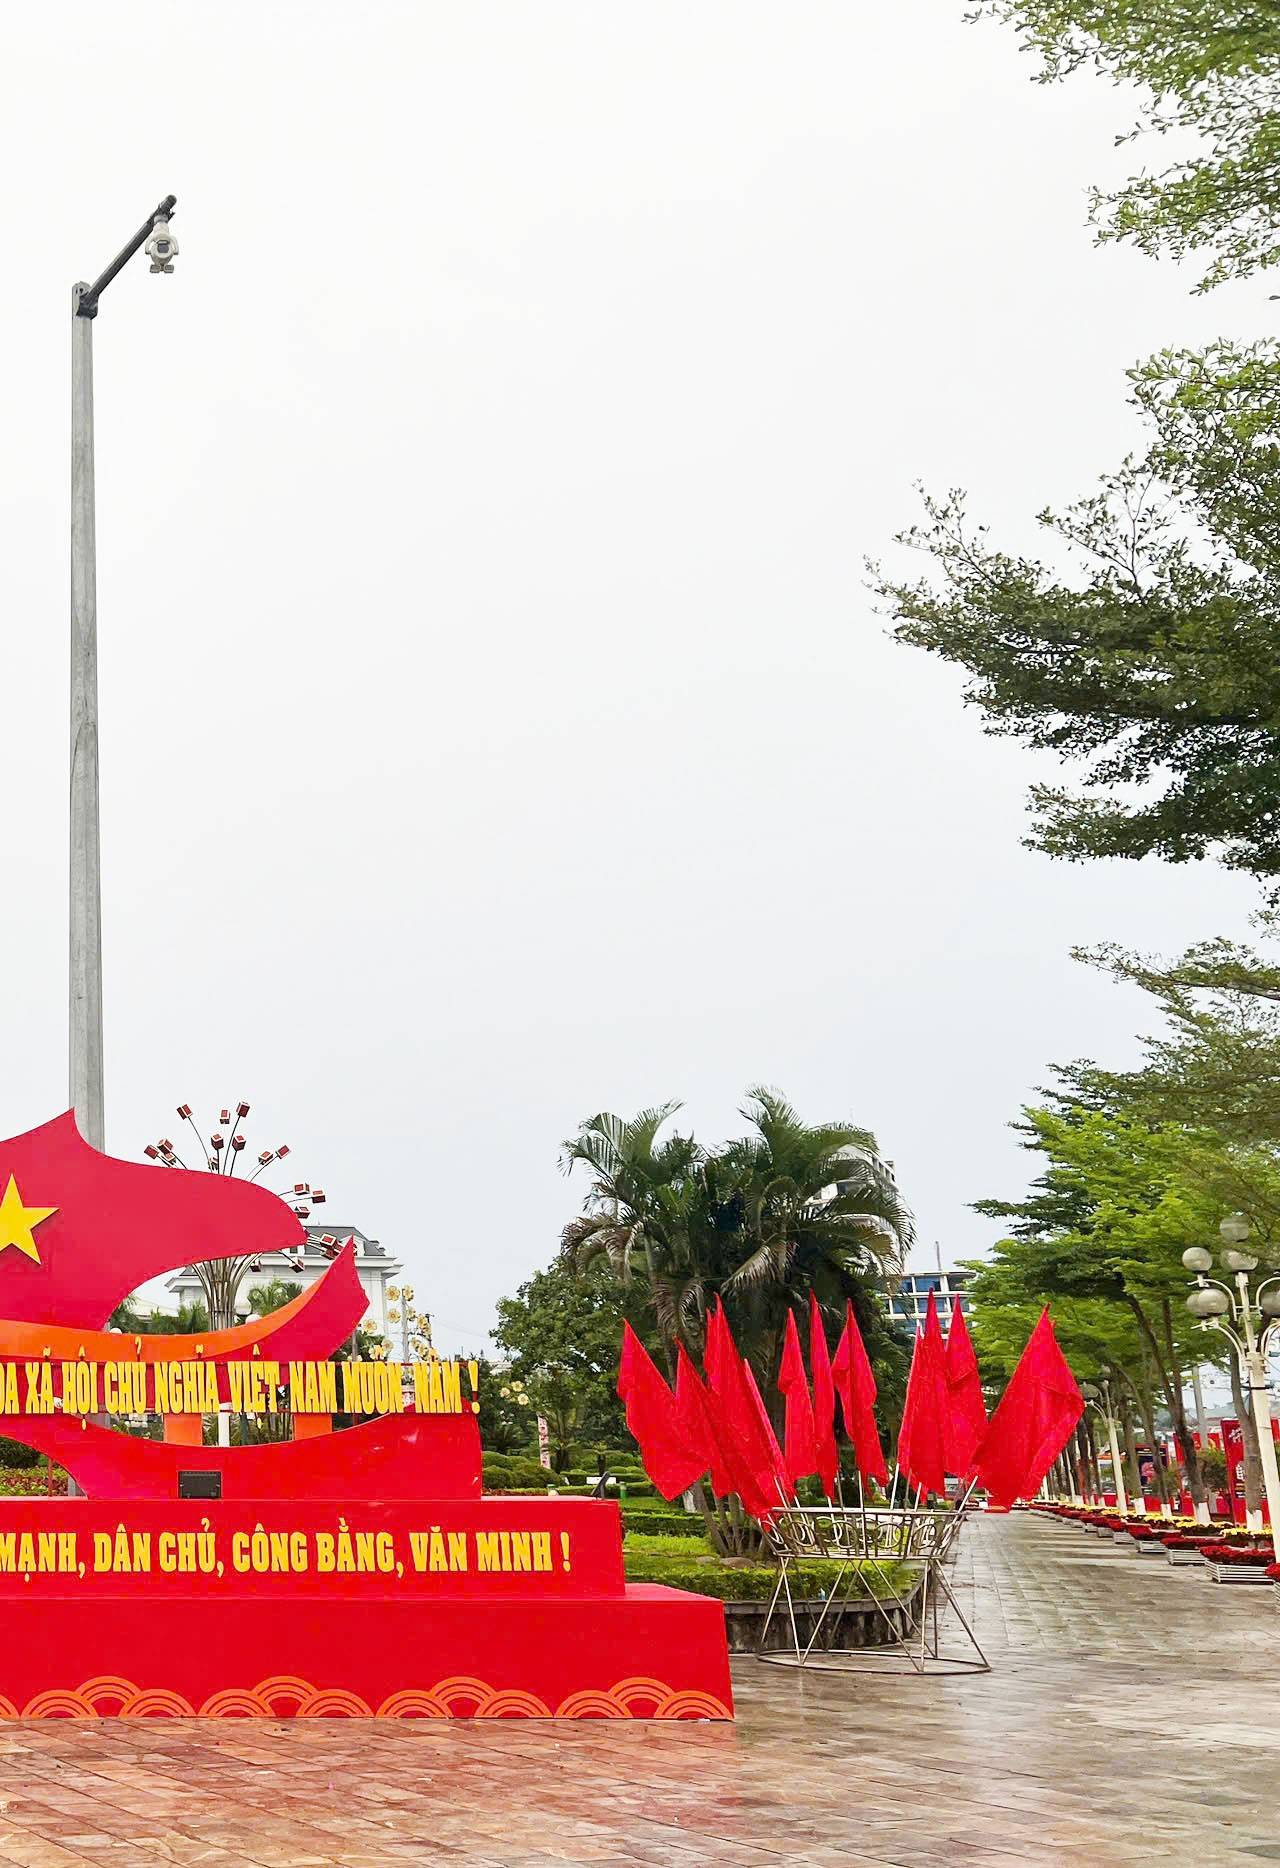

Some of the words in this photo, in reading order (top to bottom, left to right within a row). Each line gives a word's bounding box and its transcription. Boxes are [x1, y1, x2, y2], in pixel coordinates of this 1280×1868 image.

[25, 1345, 55, 1416] XÃ
[62, 1345, 99, 1431] HỘI
[104, 1335, 147, 1416] CHỦ
[154, 1344, 221, 1417] NGHĨA
[227, 1343, 281, 1430] VIỆT
[288, 1360, 338, 1414] NAM
[94, 1523, 151, 1572] DÂN
[159, 1517, 225, 1579] CHỦ,
[232, 1523, 308, 1572] CÔNG
[315, 1517, 404, 1579] BẰNG,
[410, 1525, 468, 1572] VĂN
[476, 1531, 553, 1572] MINH
